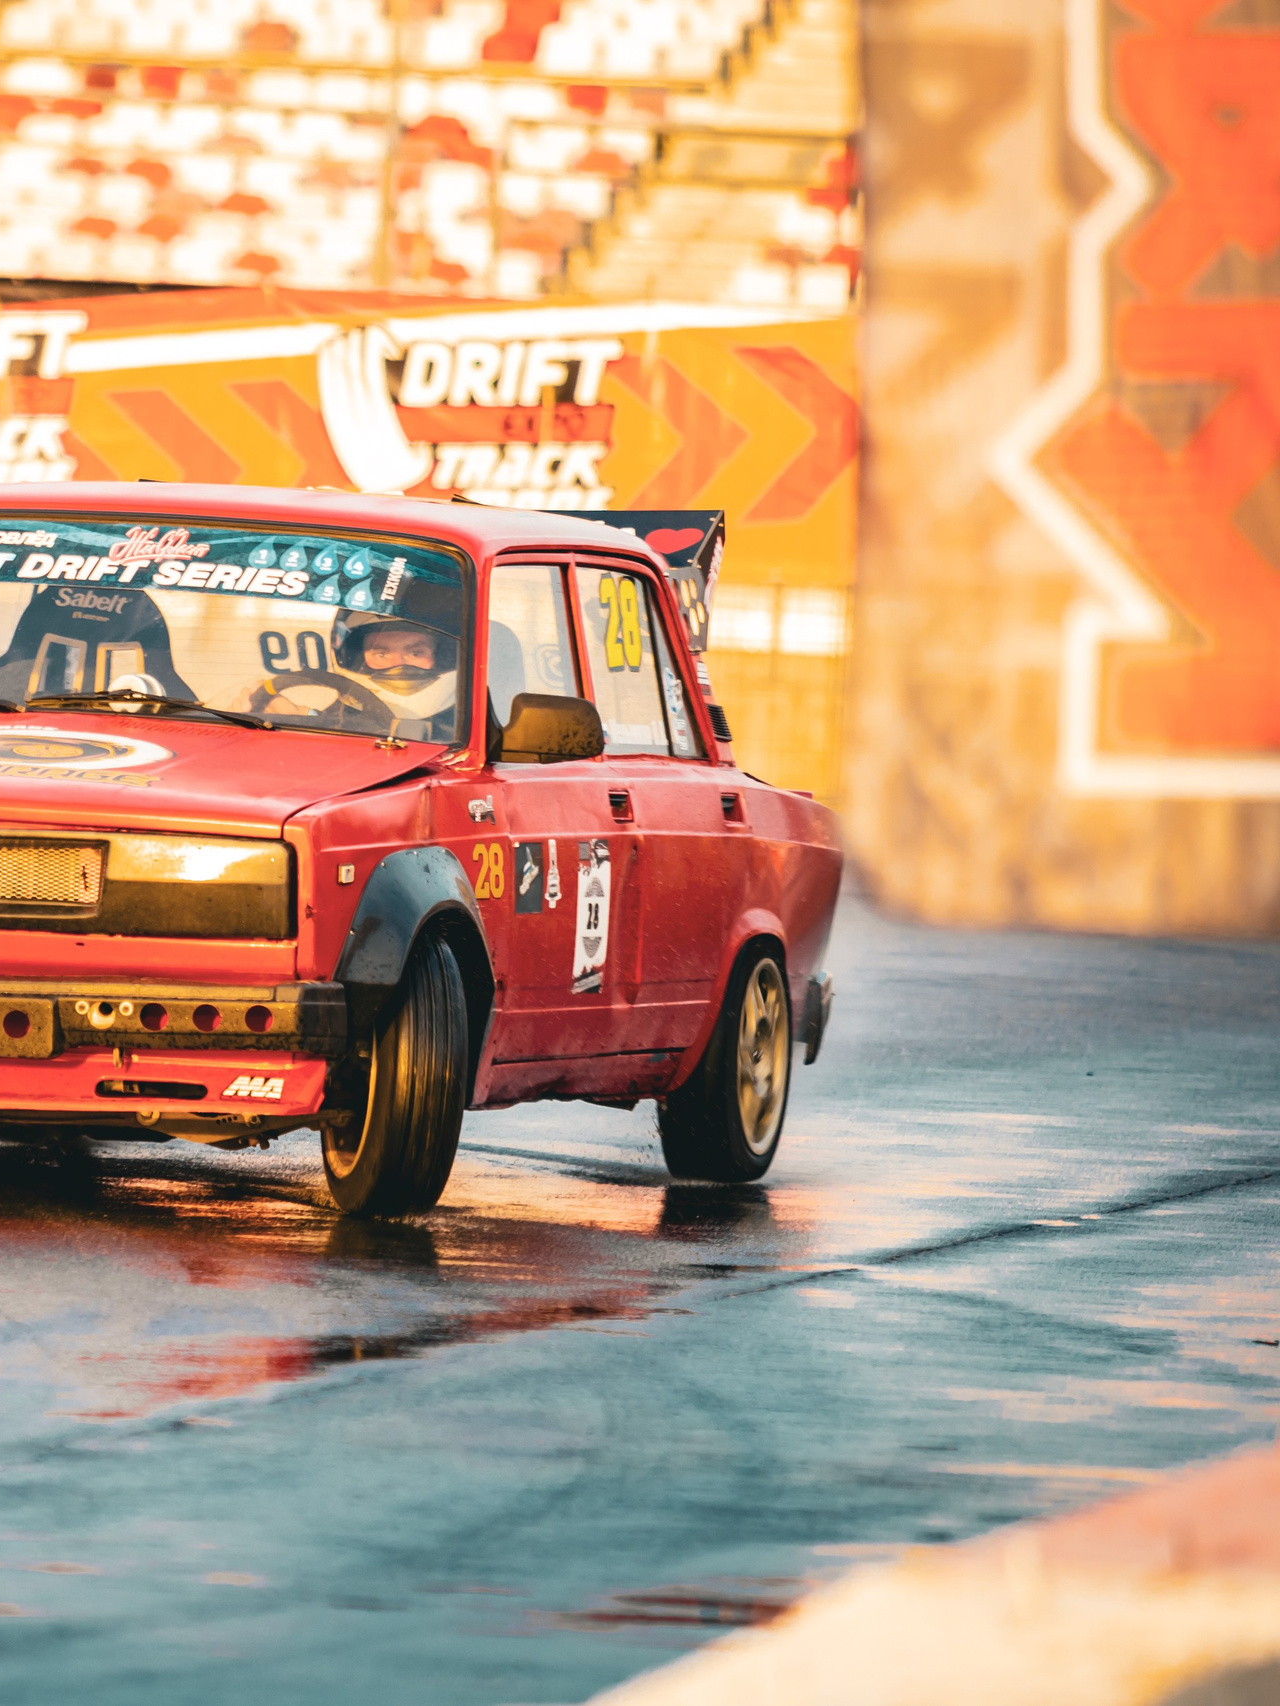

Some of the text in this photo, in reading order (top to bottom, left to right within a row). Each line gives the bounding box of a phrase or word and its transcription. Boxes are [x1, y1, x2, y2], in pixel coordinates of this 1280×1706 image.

[398, 340, 623, 407] DRIFT
[431, 442, 608, 490] TRACK
[17, 553, 150, 583] DRIFT
[152, 560, 310, 597] SERIES
[53, 587, 130, 614] Sabelt
[600, 572, 642, 672] 28
[473, 843, 504, 898] 28
